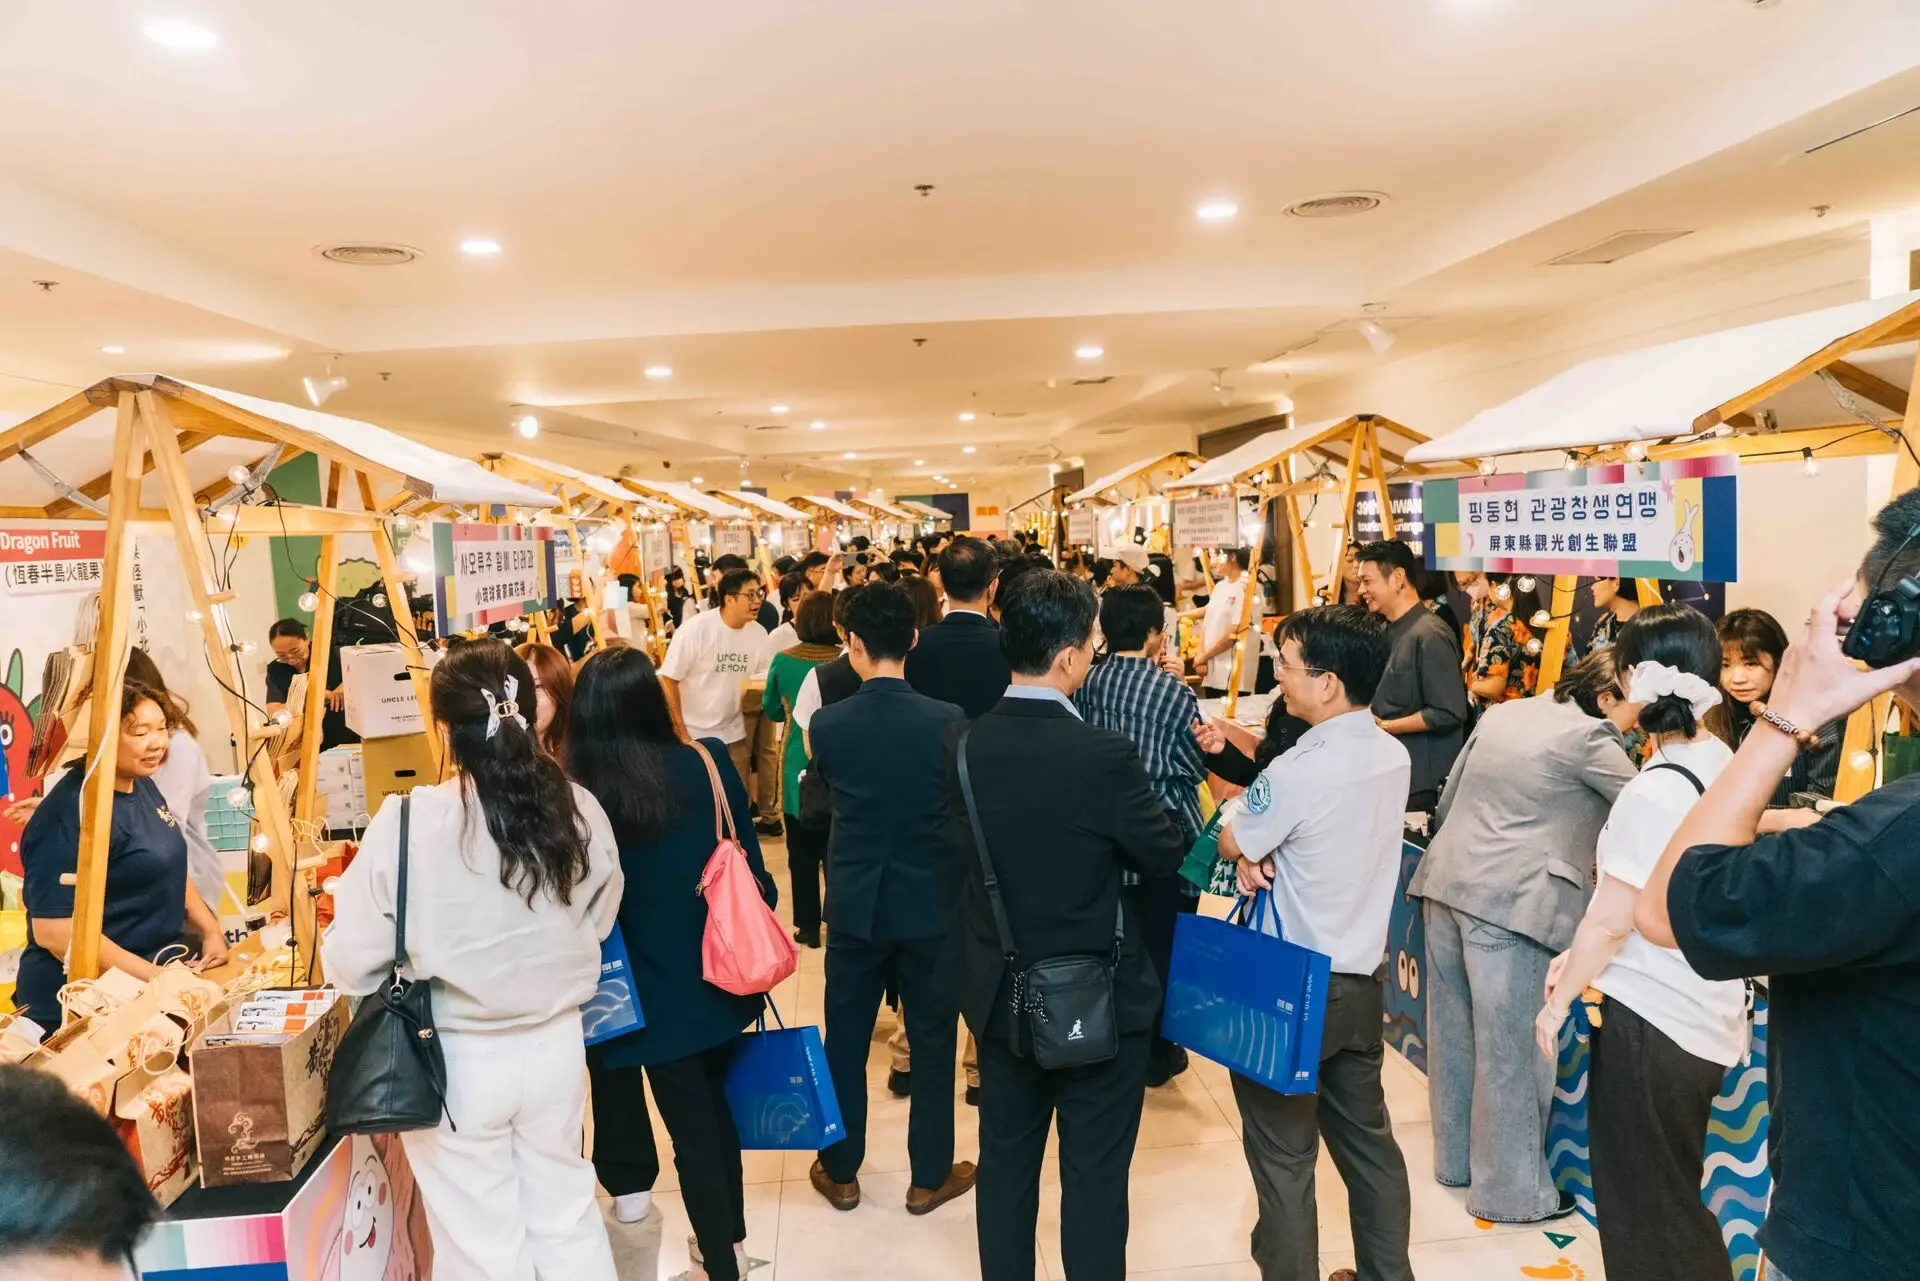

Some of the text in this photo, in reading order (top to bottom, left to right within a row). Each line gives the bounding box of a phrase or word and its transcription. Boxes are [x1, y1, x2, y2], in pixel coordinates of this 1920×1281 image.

[1468, 490, 1658, 524] 핑둥현 관광창생연맹
[0, 530, 82, 555] Dragon Fruit
[1488, 532, 1638, 552] 屏東縣觀光創生聯盟
[717, 652, 749, 663] UNCLE
[715, 663, 748, 673] LEMON
[381, 696, 404, 704] UNCLE
